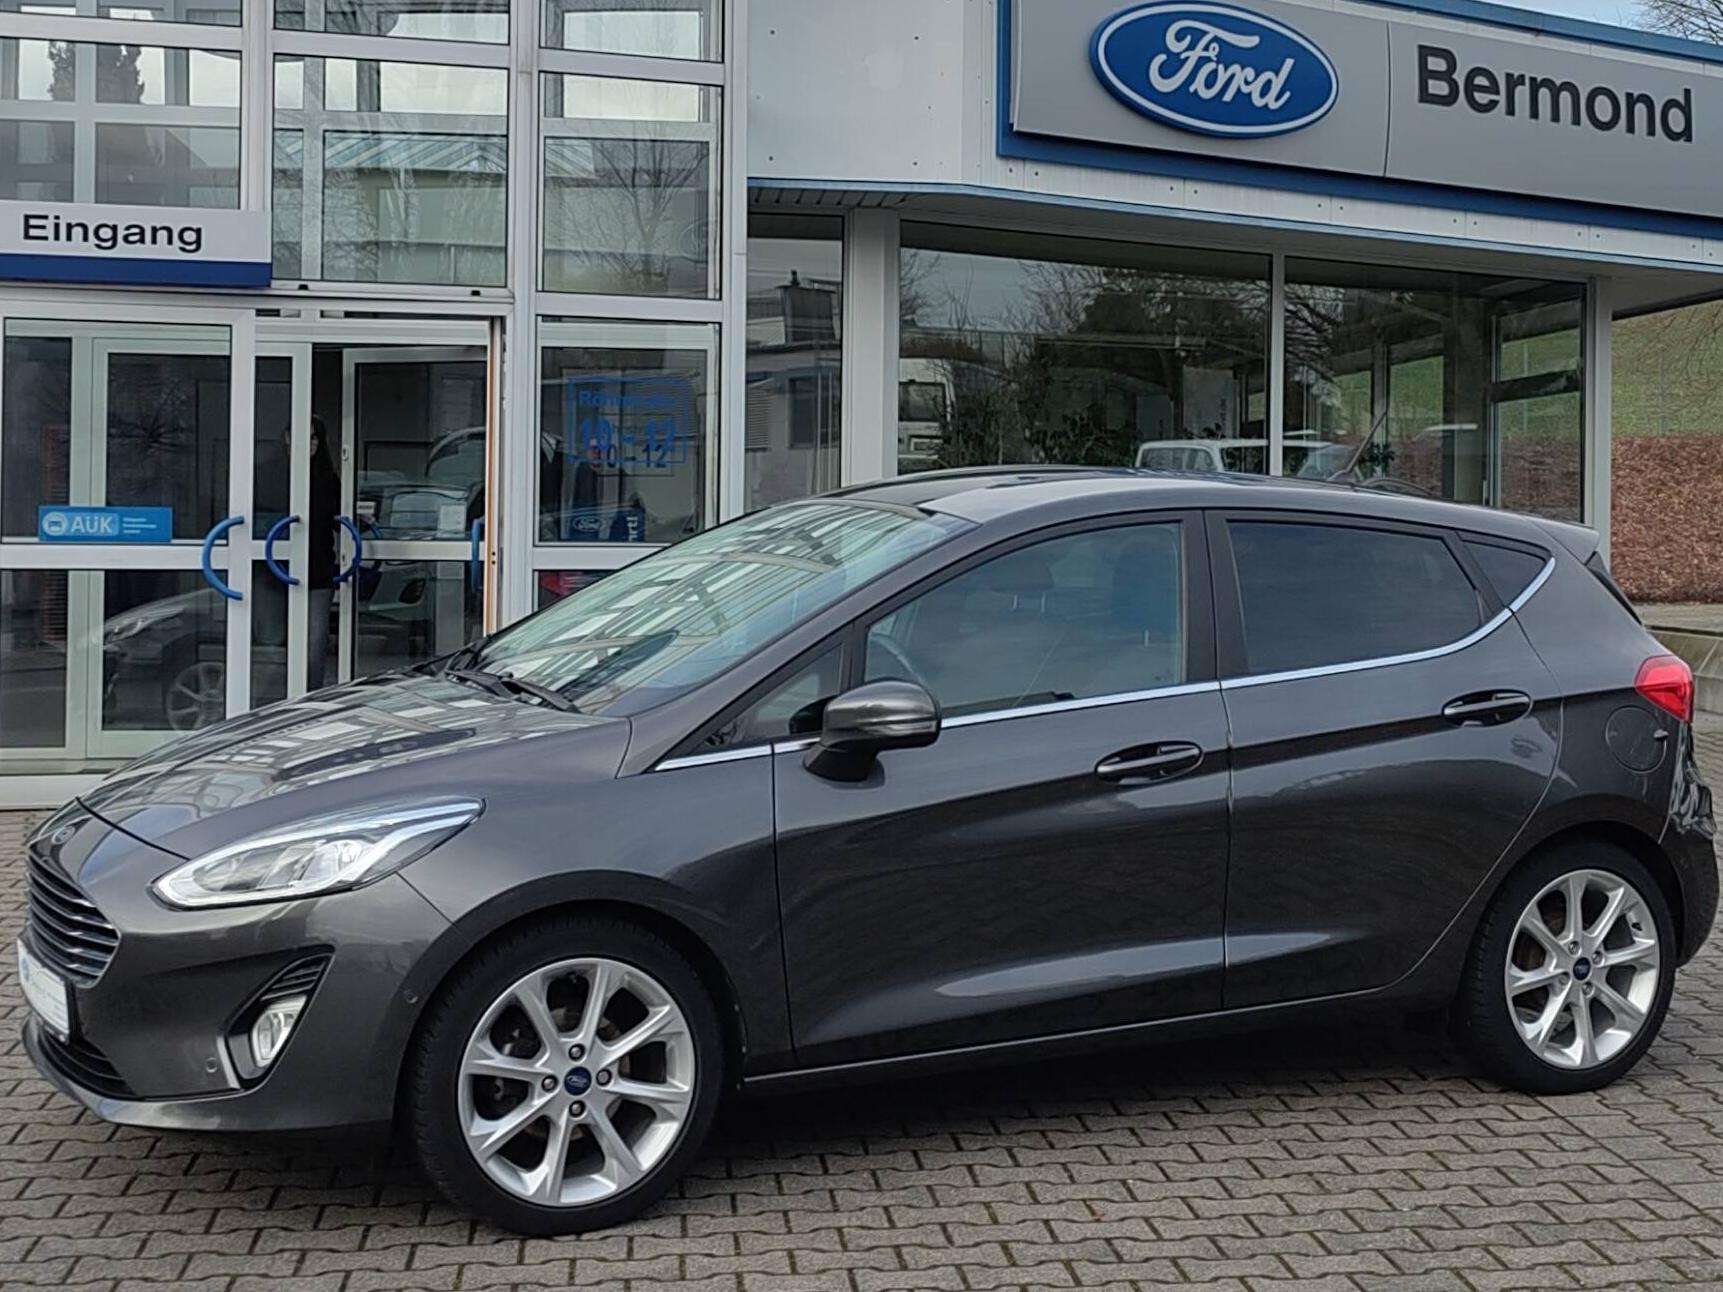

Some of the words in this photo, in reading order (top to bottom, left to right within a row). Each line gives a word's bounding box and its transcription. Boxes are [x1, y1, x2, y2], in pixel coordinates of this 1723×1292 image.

[1149, 19, 1293, 111] Ford
[1417, 44, 1693, 142] Bermond
[23, 213, 202, 254] Eingang
